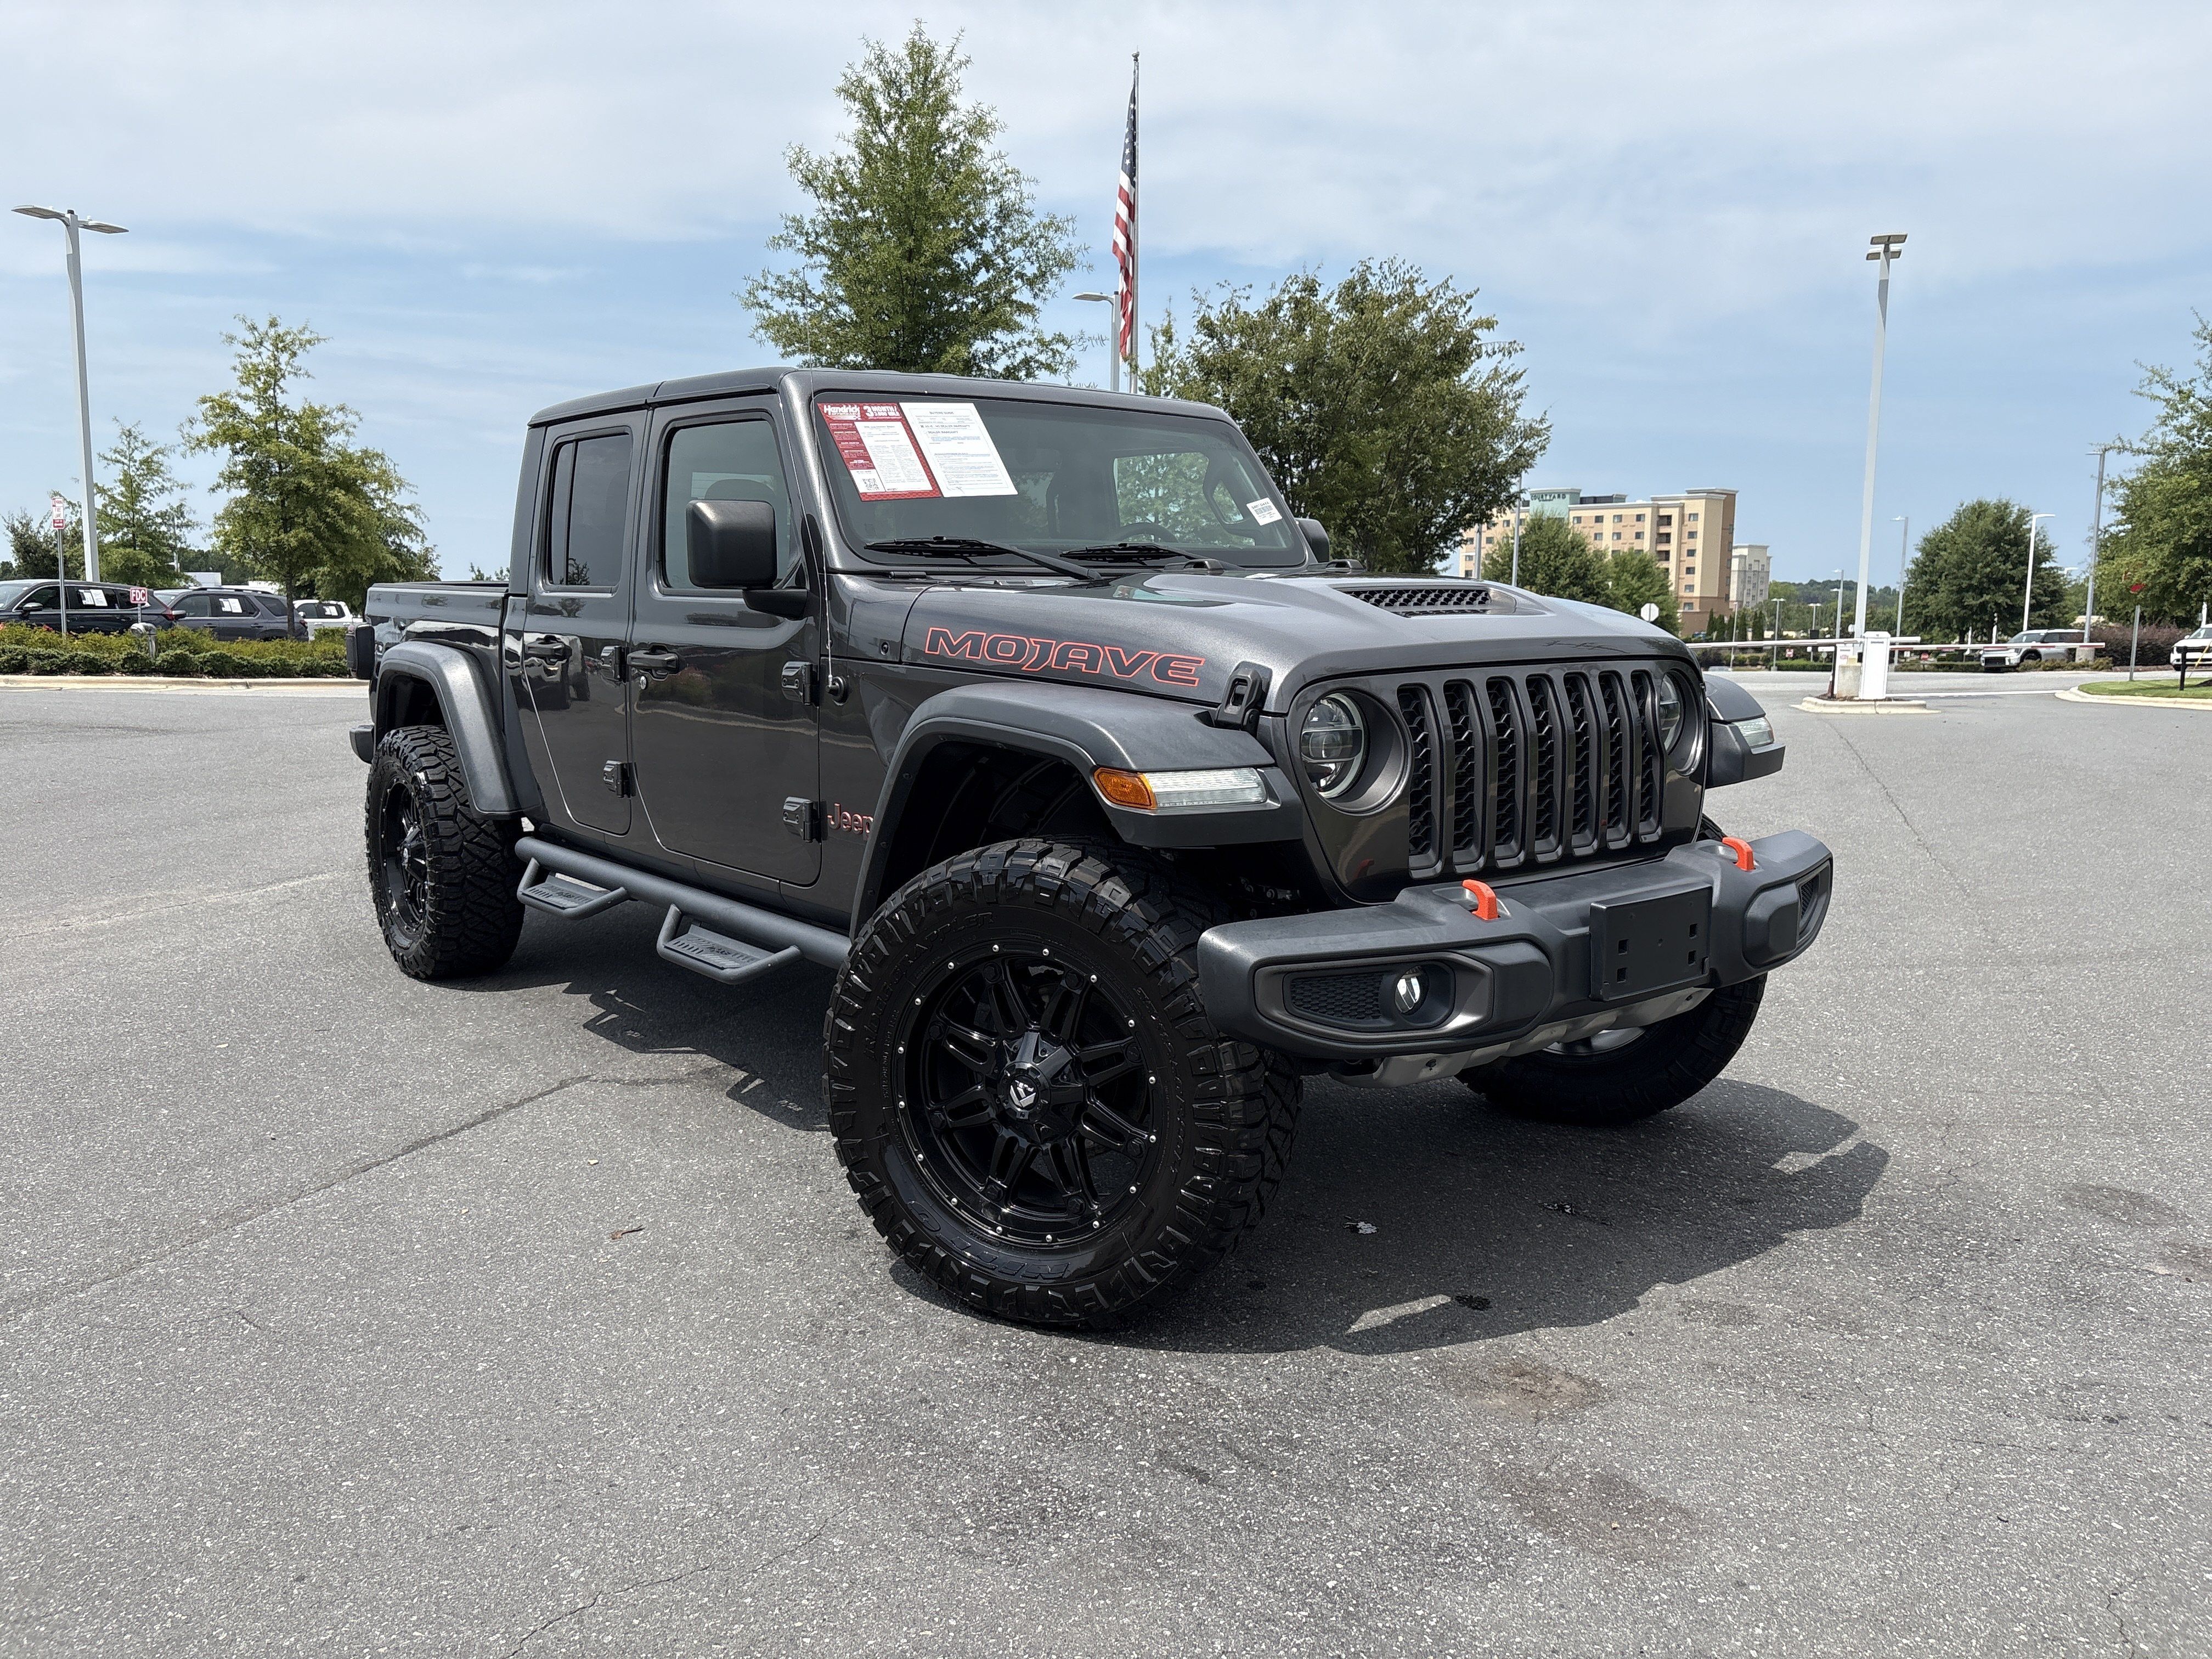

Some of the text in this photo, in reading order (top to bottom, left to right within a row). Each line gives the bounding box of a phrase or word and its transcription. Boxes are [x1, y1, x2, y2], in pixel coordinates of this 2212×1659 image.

[823, 404, 860, 415] Hendrick
[863, 405, 874, 417] 3
[131, 589, 145, 601] FDC
[925, 627, 1205, 686] MOJAVE
[907, 1200, 1070, 1281] NITTO
